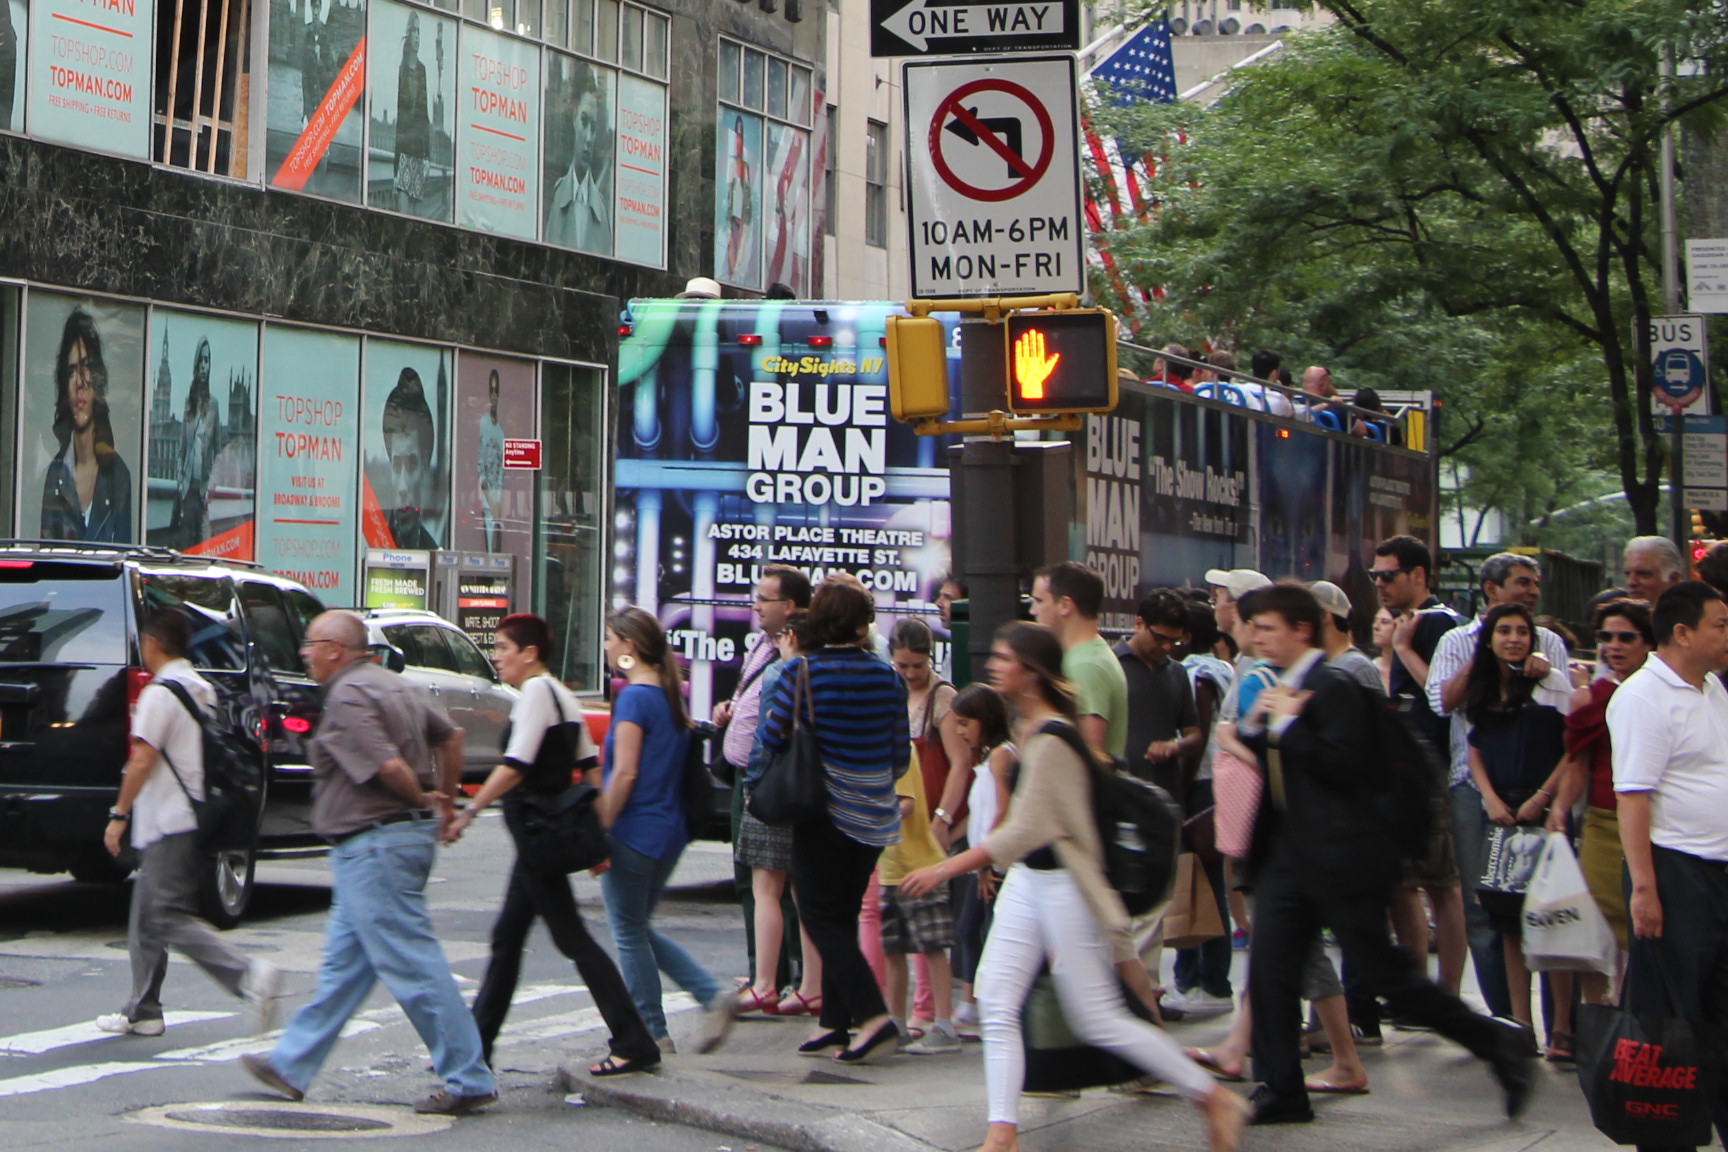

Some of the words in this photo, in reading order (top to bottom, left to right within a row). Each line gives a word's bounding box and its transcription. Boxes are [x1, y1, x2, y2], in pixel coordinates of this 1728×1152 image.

[908, 8, 970, 36] ONE
[986, 4, 1051, 33] WAY
[51, 34, 134, 74] TOPSHOP.COM
[49, 65, 132, 103] TOPMAN.COM
[325, 51, 364, 116] TOPMAN.COM
[472, 54, 528, 91] TOPSHOP
[48, 95, 61, 107] FREE
[62, 97, 90, 114] SHIPPING
[93, 104, 106, 116] FREE
[106, 107, 132, 123] RETURNS
[471, 87, 528, 124] TOPMAN
[620, 134, 661, 162] TOPMAN
[470, 166, 525, 194] TOPMAN.COM
[922, 216, 1069, 246] 10AM-6PM
[931, 252, 1062, 280] MON-FRI
[1649, 323, 1692, 343] BUS
[860, 357, 885, 375] NY
[276, 395, 343, 427] TOPSHOP
[749, 381, 887, 426] BLUE
[275, 432, 343, 462] TOPMAN
[747, 425, 887, 475] MAN
[1086, 413, 1141, 480] BLUE
[746, 472, 886, 507] GROUP
[1175, 459, 1205, 501] Show
[1086, 476, 1141, 552] MAN
[273, 538, 340, 558] TOPSHOP.COM
[707, 523, 771, 541] ASTOR
[774, 525, 835, 544] PLACE
[839, 528, 924, 547] THEATRE
[382, 553, 413, 563] Phone
[727, 544, 763, 560] 434
[767, 546, 870, 565] LAFAYETTE
[874, 550, 902, 566] ST.
[371, 577, 393, 588] FRESH
[394, 578, 418, 589] MADE
[371, 586, 393, 594] FRESH
[394, 587, 425, 596] BREWED
[1480, 826, 1505, 888] Abercrombie
[1614, 1037, 1664, 1066] BEAT
[1609, 1060, 1697, 1089] AVERAGE
[1625, 1100, 1681, 1117] GNC
